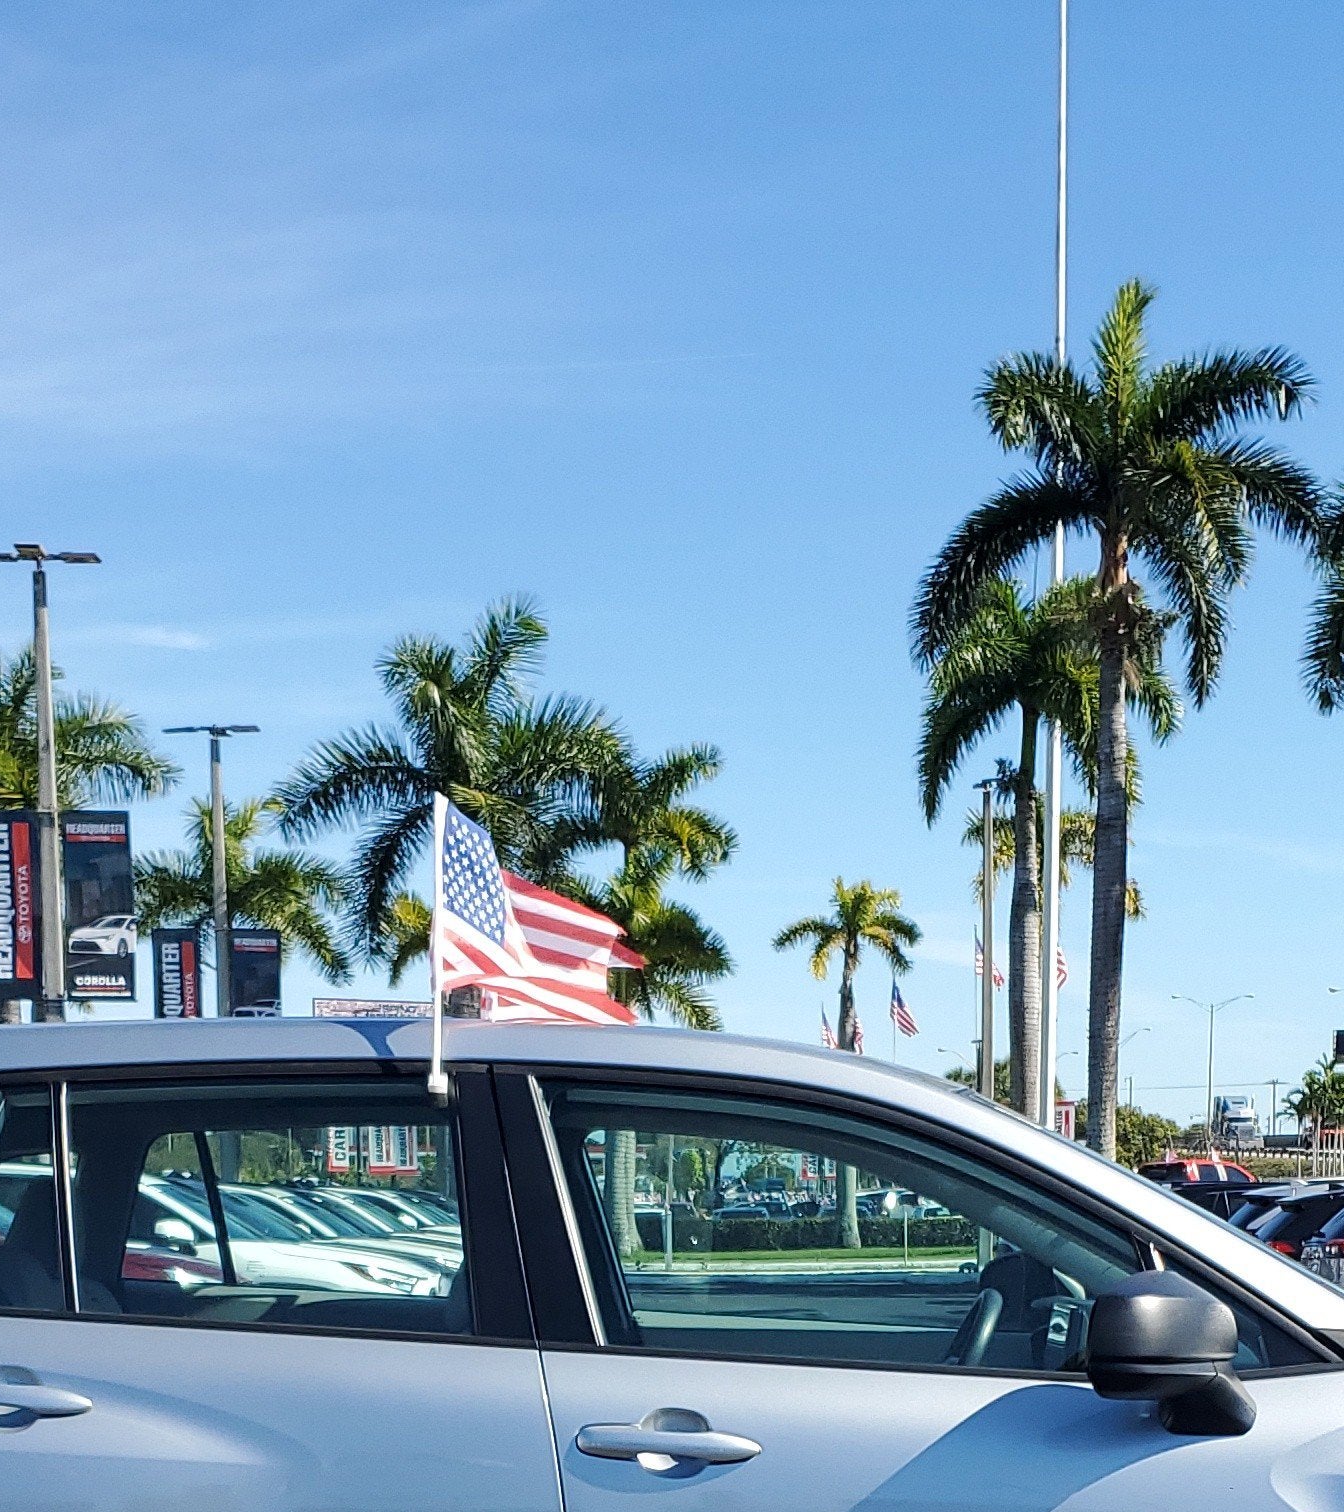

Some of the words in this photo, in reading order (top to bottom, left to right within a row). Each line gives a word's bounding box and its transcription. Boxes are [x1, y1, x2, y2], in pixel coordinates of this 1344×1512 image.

[18, 865, 29, 922] TOYOTA
[74, 975, 126, 986] COROLLA
[162, 943, 184, 1018] QUARTER
